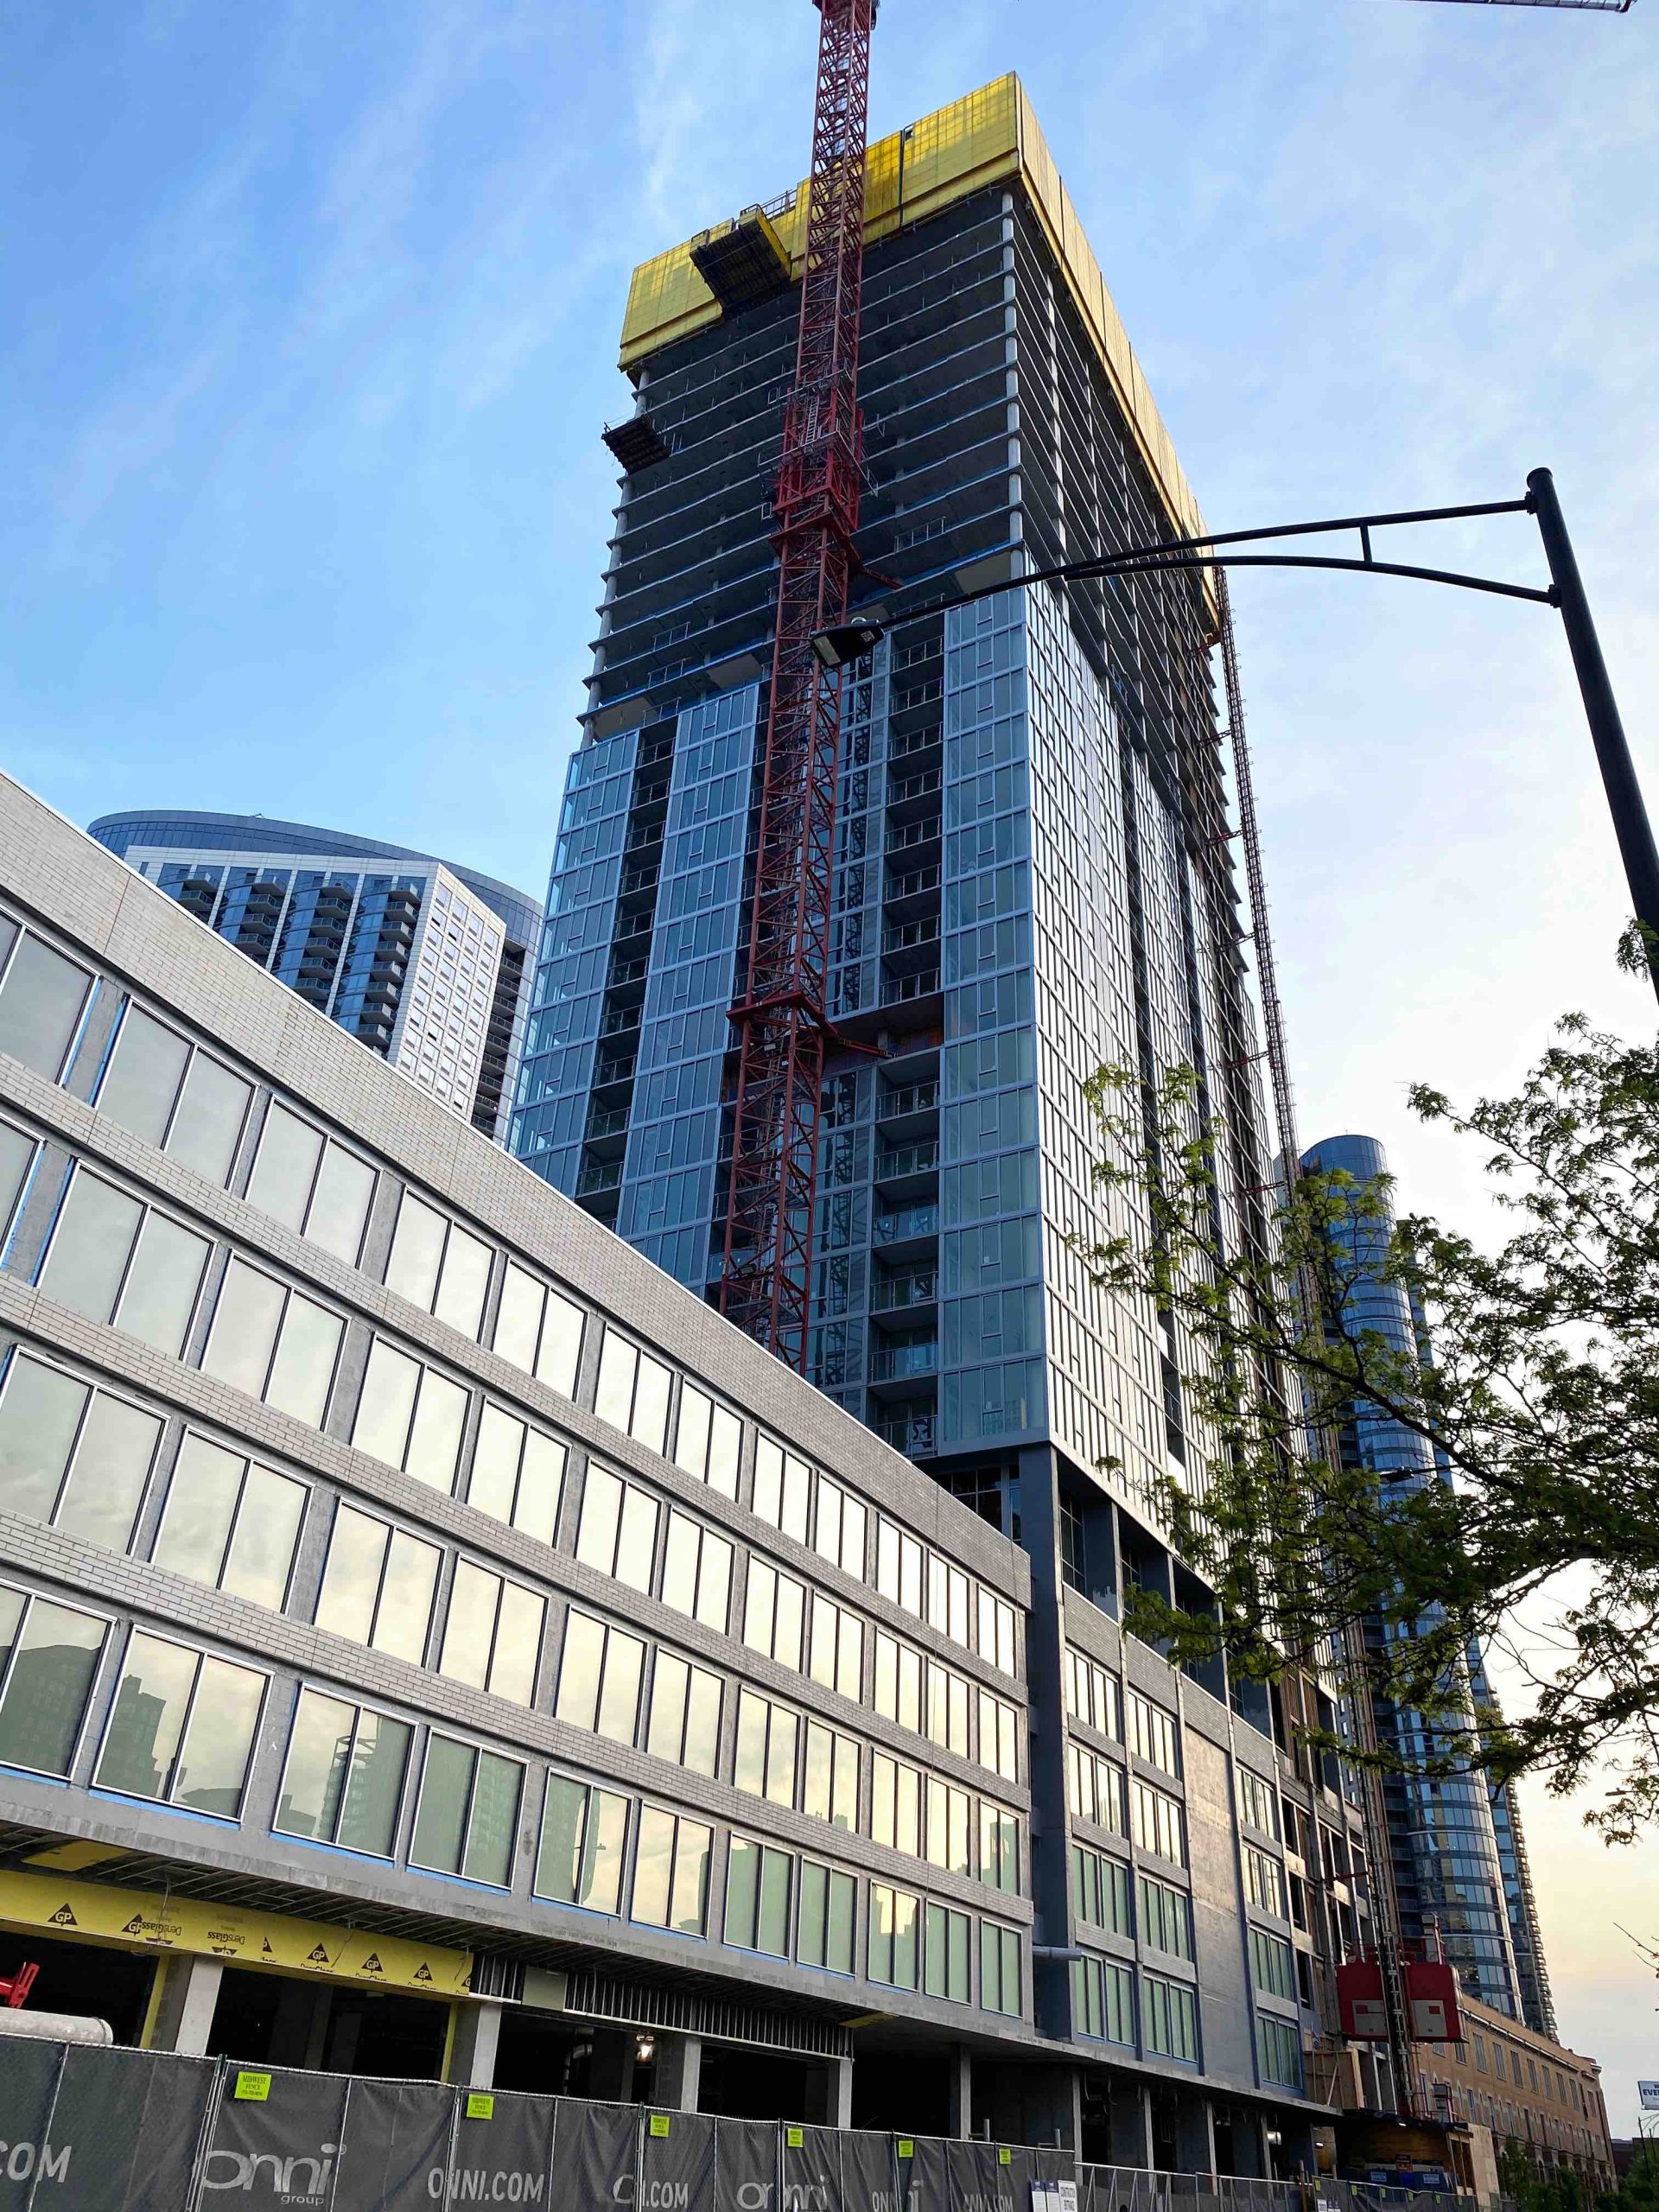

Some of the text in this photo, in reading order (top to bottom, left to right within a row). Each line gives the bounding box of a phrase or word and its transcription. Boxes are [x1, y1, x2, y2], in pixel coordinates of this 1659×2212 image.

[54, 1911, 73, 1923] GP
[207, 1931, 245, 1945] DensGlass
[312, 1950, 325, 1960] GP
[366, 1960, 379, 1969] GP
[417, 1970, 429, 1979] GP
[281, 2195, 325, 2206] group
